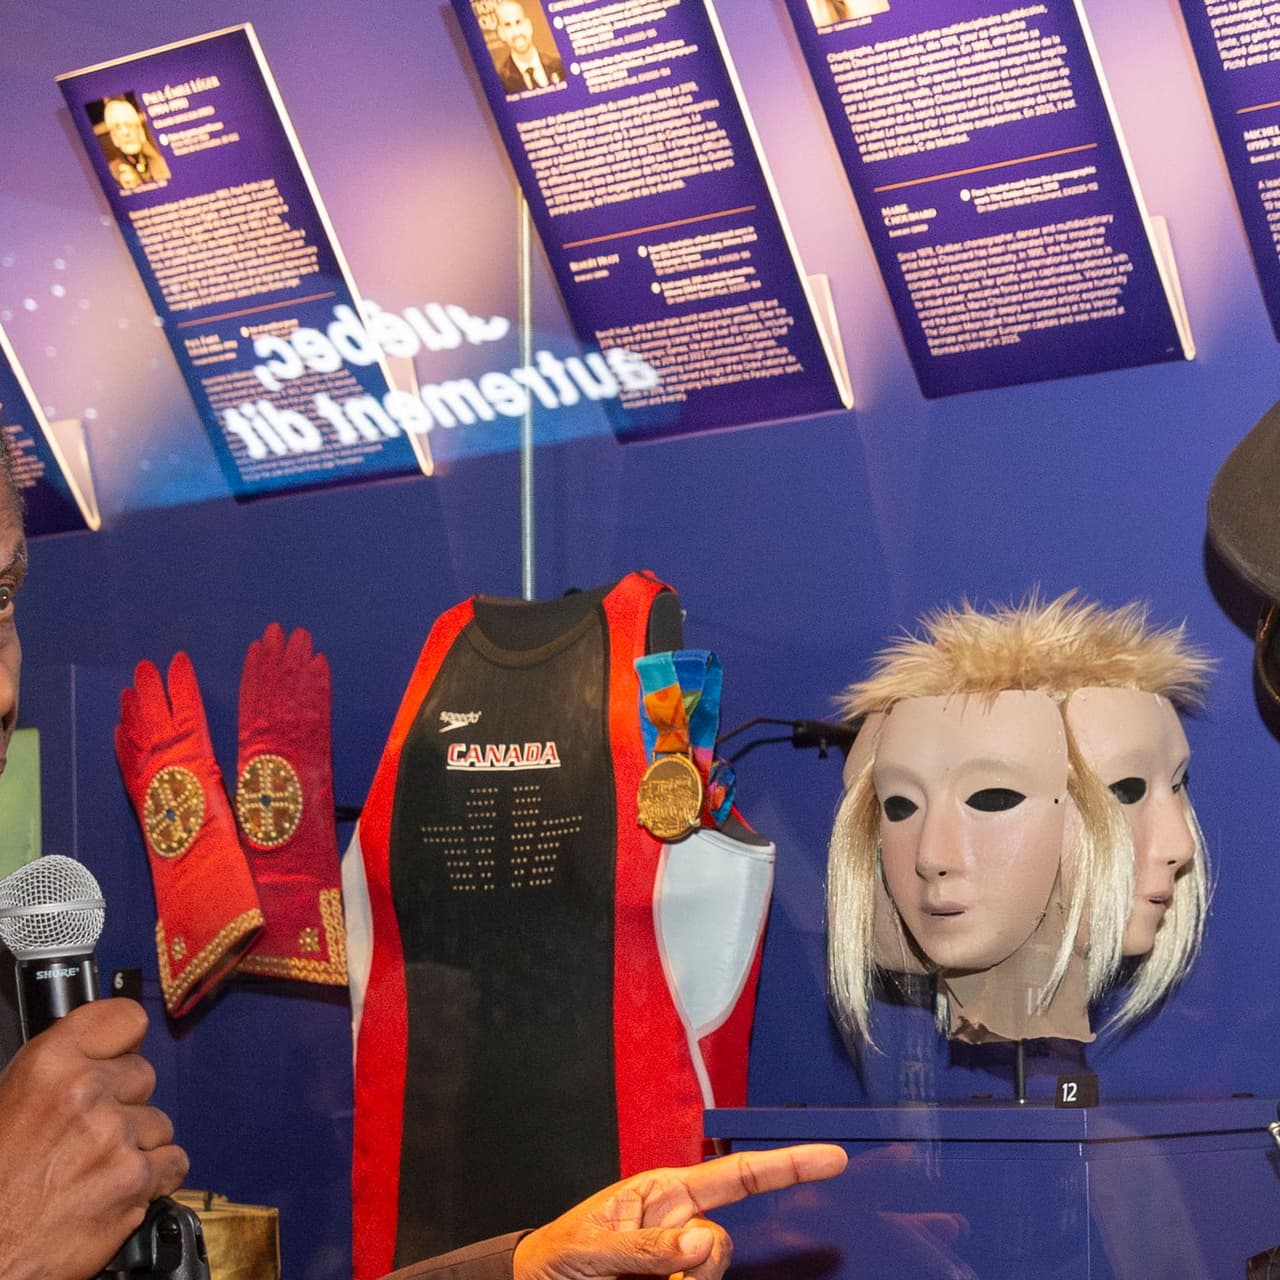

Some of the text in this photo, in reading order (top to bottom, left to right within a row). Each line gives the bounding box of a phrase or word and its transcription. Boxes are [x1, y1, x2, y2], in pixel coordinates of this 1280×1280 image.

[447, 742, 561, 767] CANADA
[114, 972, 124, 990] 6
[1062, 1083, 1078, 1102] 12
